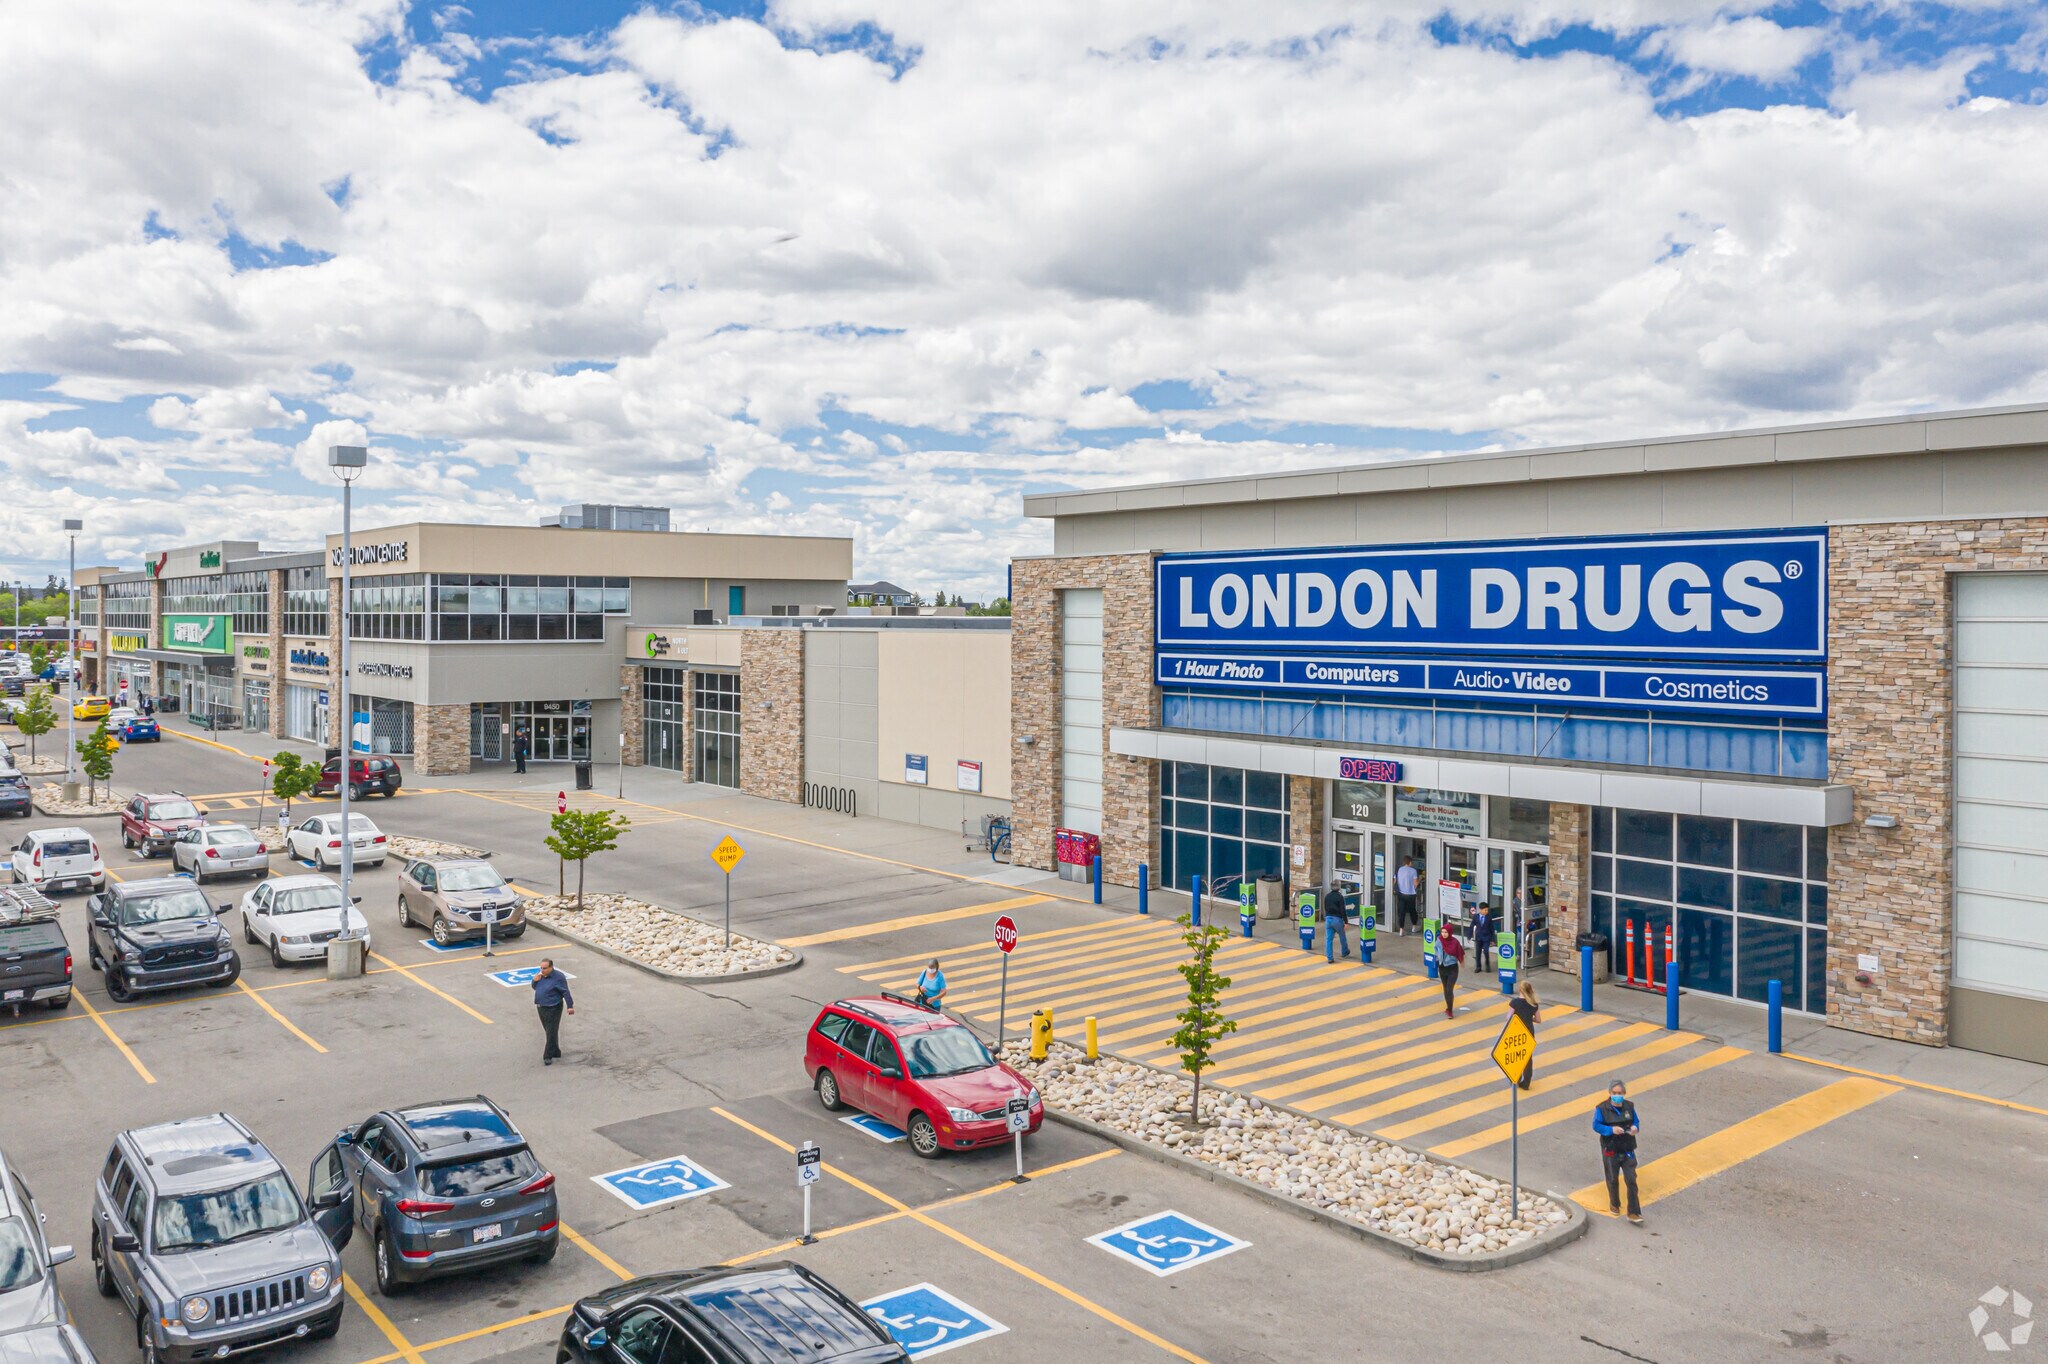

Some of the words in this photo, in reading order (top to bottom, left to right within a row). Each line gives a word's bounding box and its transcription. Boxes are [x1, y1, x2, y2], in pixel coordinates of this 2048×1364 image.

[355, 545, 377, 564] TOWN
[378, 541, 407, 563] CENTRE
[1179, 568, 1437, 629] LONDON
[1175, 661, 1182, 675] 1
[1185, 661, 1219, 677] Hour
[1221, 662, 1264, 679] Photo
[1305, 663, 1399, 684] Computers
[1644, 676, 1769, 701] Cosmetics
[543, 703, 560, 711] 9450
[1340, 758, 1397, 782] OPEN
[1351, 804, 1369, 818] 120
[1408, 812, 1430, 820] Mon-Sat
[1417, 804, 1436, 813] Store
[1437, 806, 1459, 816] Hours
[718, 845, 738, 854] SPEED
[719, 854, 737, 863] BUMP
[1341, 872, 1354, 881] OUT
[995, 925, 1016, 944] STOP
[1503, 1033, 1527, 1050] SPEED
[1504, 1048, 1527, 1065] BUMP
[799, 1150, 818, 1158] Parking
